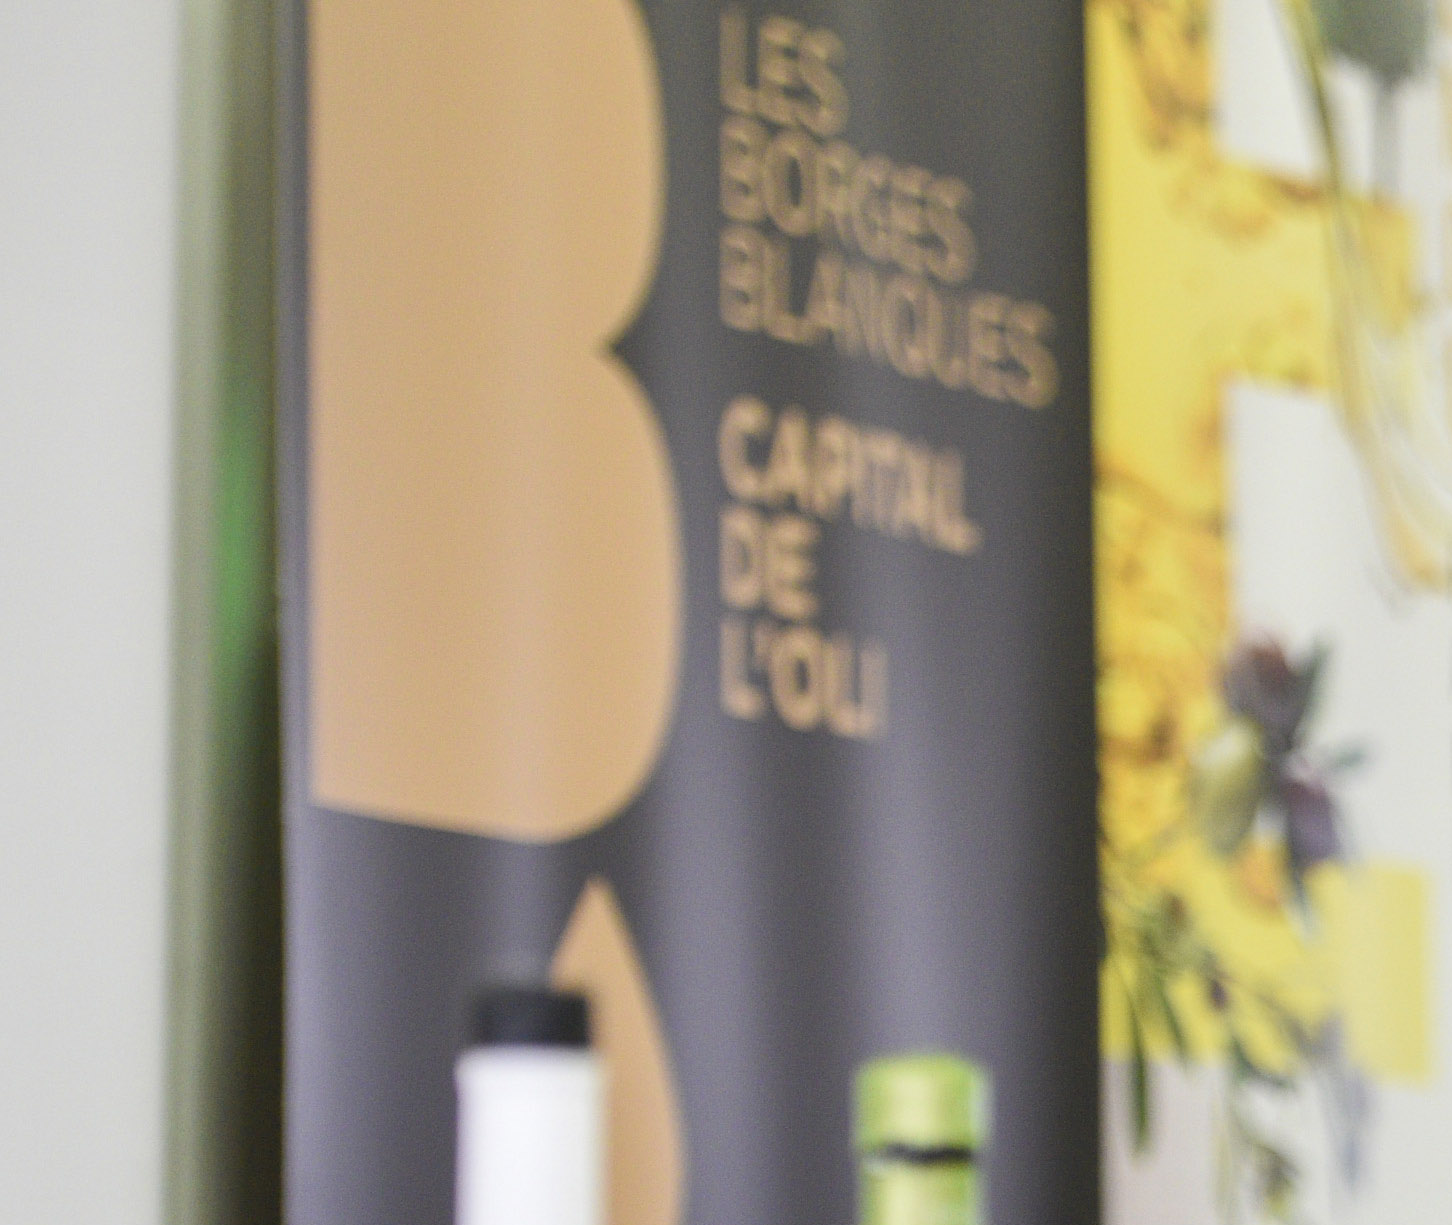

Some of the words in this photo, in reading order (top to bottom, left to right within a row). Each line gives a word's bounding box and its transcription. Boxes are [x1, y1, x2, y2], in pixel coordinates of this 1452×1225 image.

[719, 10, 850, 137] LES
[717, 116, 977, 285] BORGES
[717, 224, 1062, 410] BLANQUES
[718, 398, 983, 555] CAPITAL
[720, 505, 820, 620] DE
[718, 618, 889, 741] L'OLI
